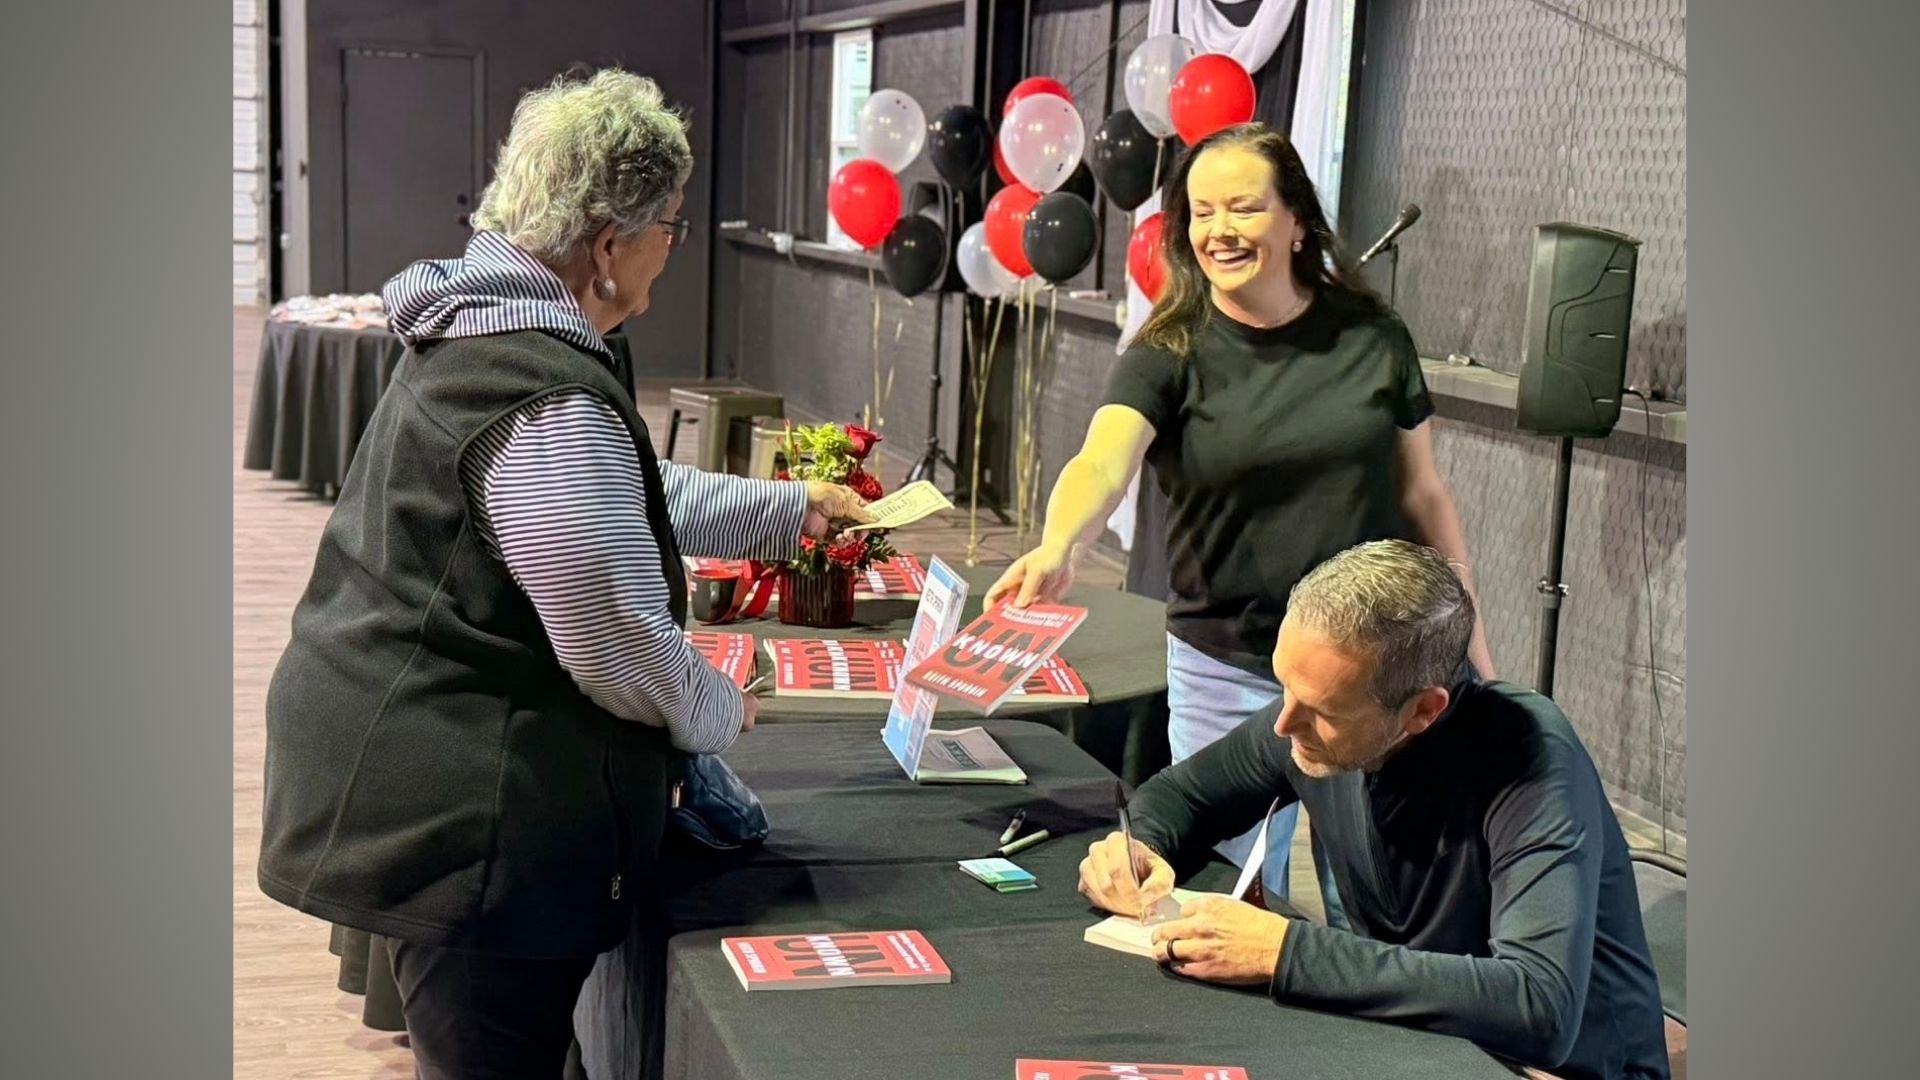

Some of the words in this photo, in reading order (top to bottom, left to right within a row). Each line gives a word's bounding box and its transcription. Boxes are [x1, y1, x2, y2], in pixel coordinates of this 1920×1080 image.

[943, 619, 1056, 683] UN
[952, 633, 1041, 669] KNOWN
[774, 934, 895, 977] UN
[804, 935, 856, 977] KNOWN
